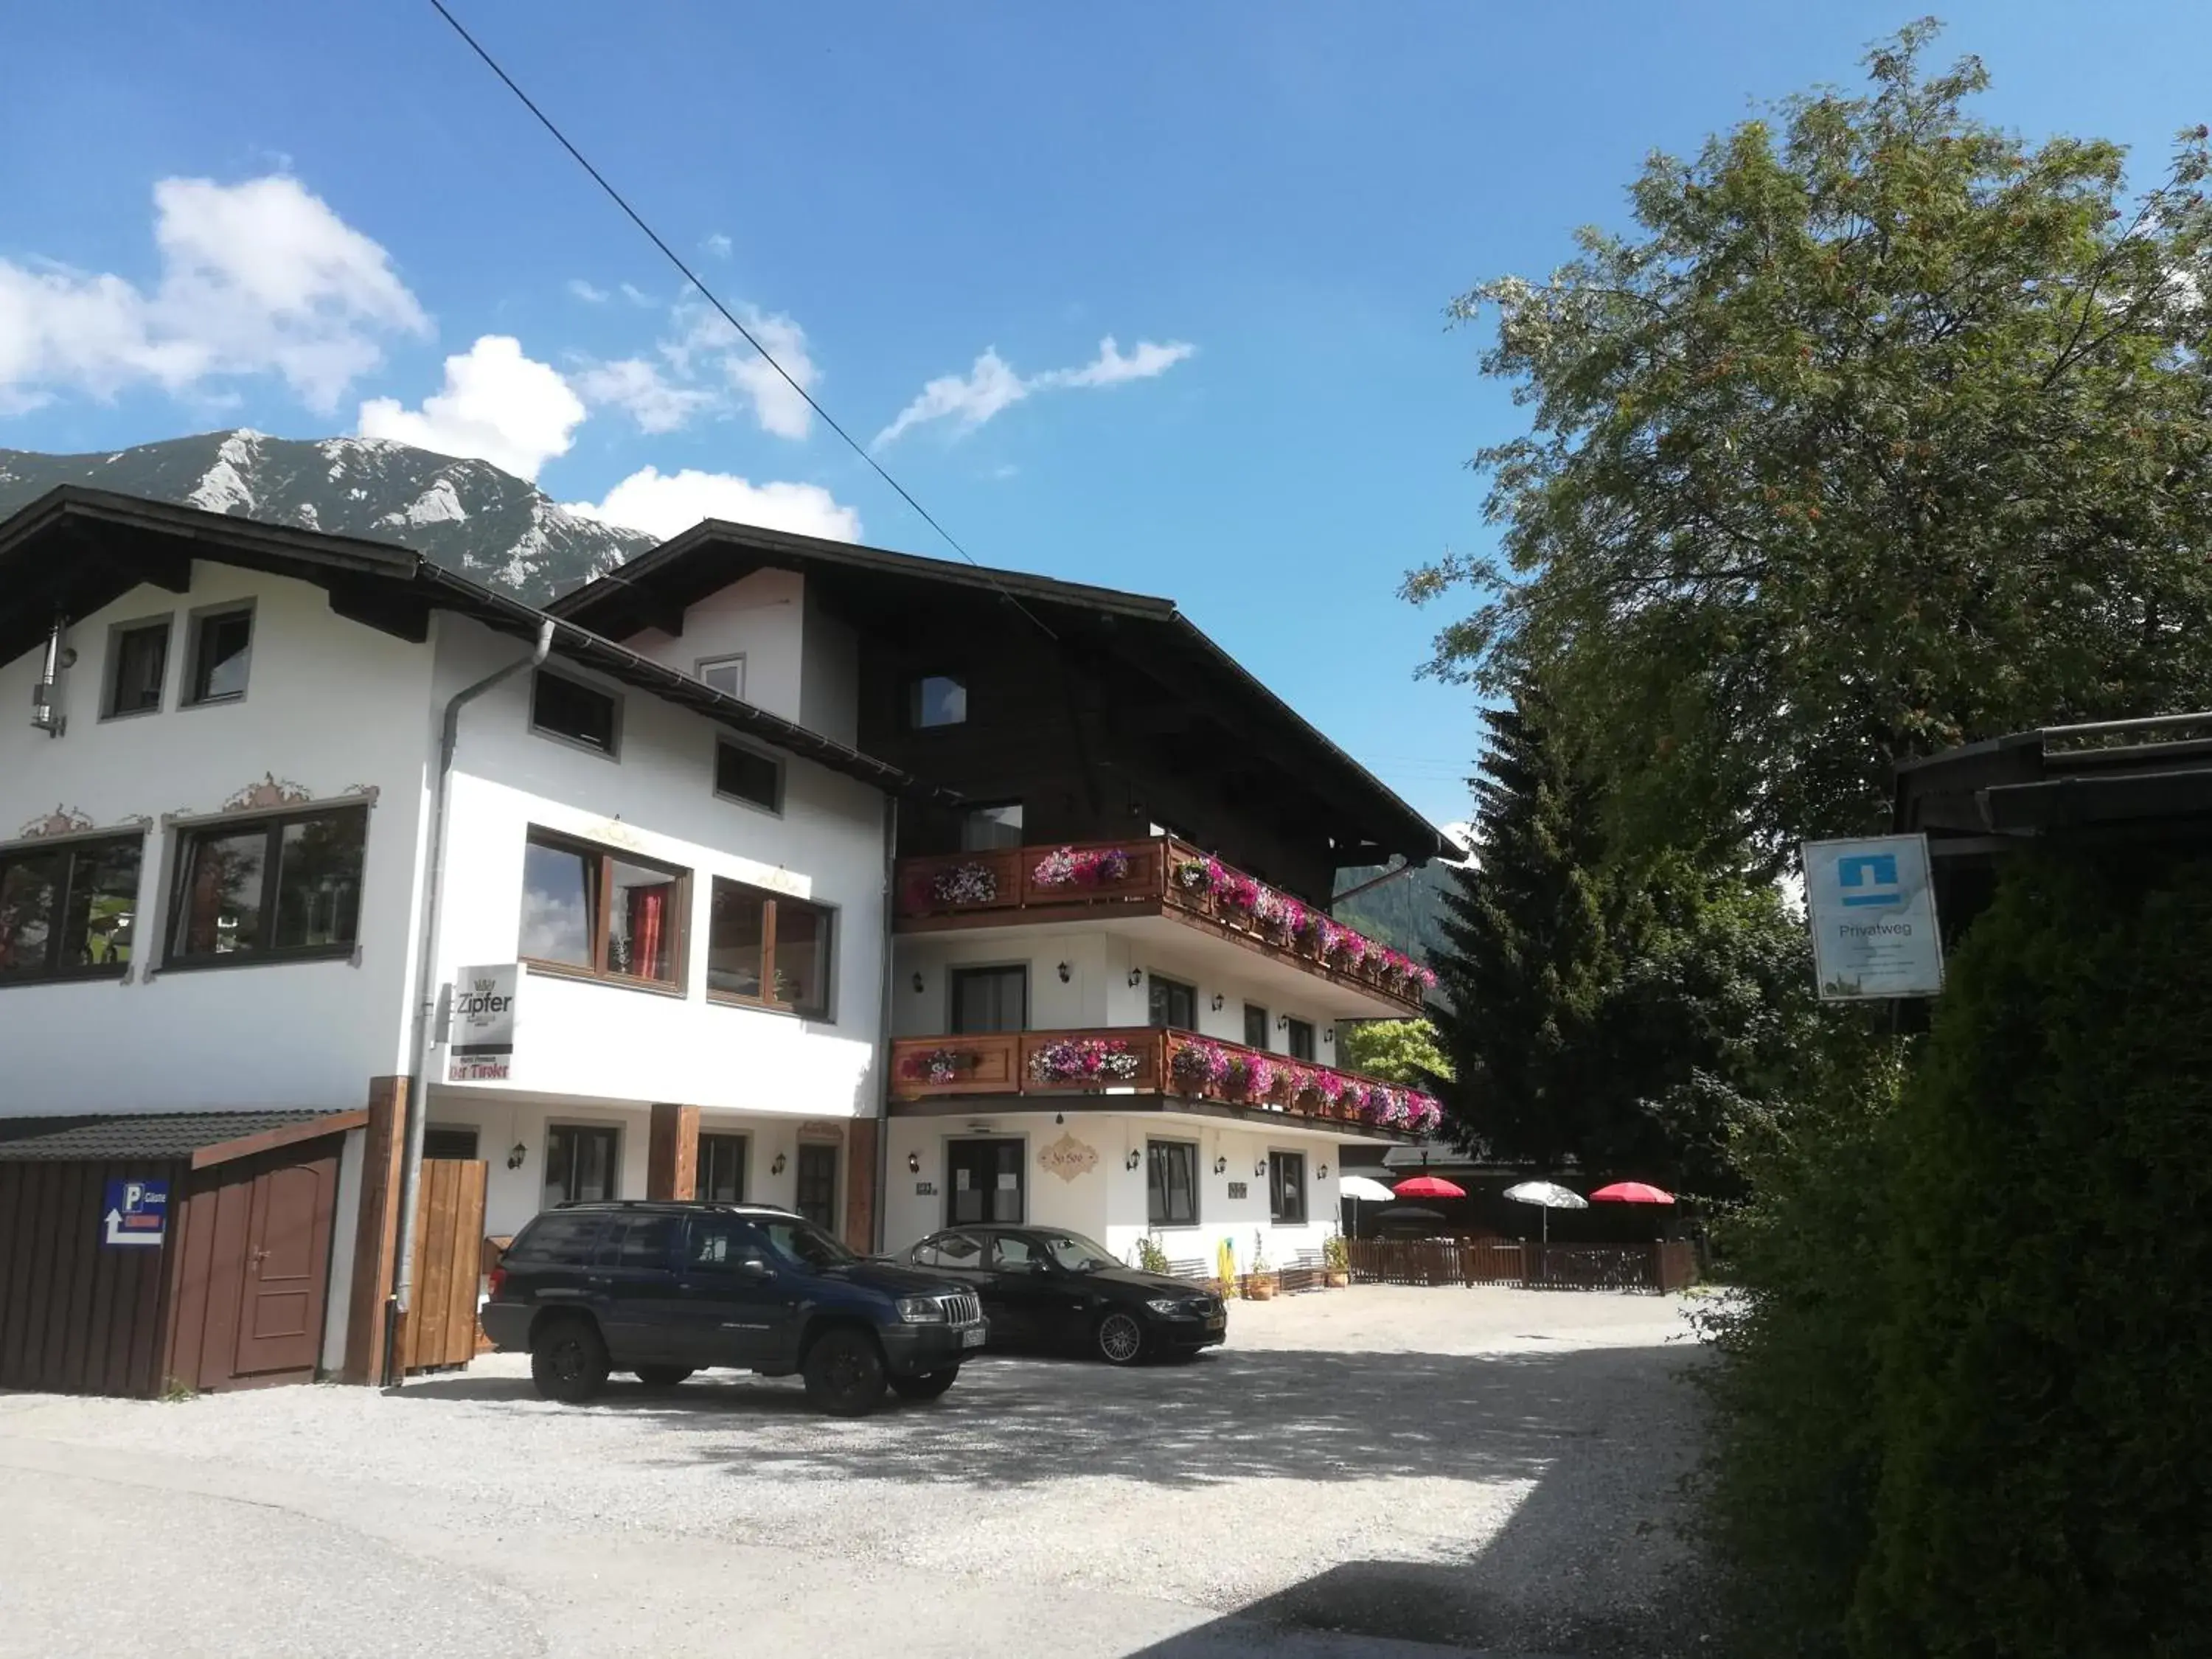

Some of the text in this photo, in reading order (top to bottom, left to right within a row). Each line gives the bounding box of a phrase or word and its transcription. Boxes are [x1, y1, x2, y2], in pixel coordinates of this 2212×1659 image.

[1839, 923, 1912, 938] Privatweg
[457, 992, 512, 1017] Zipfer
[126, 1186, 141, 1210] P
